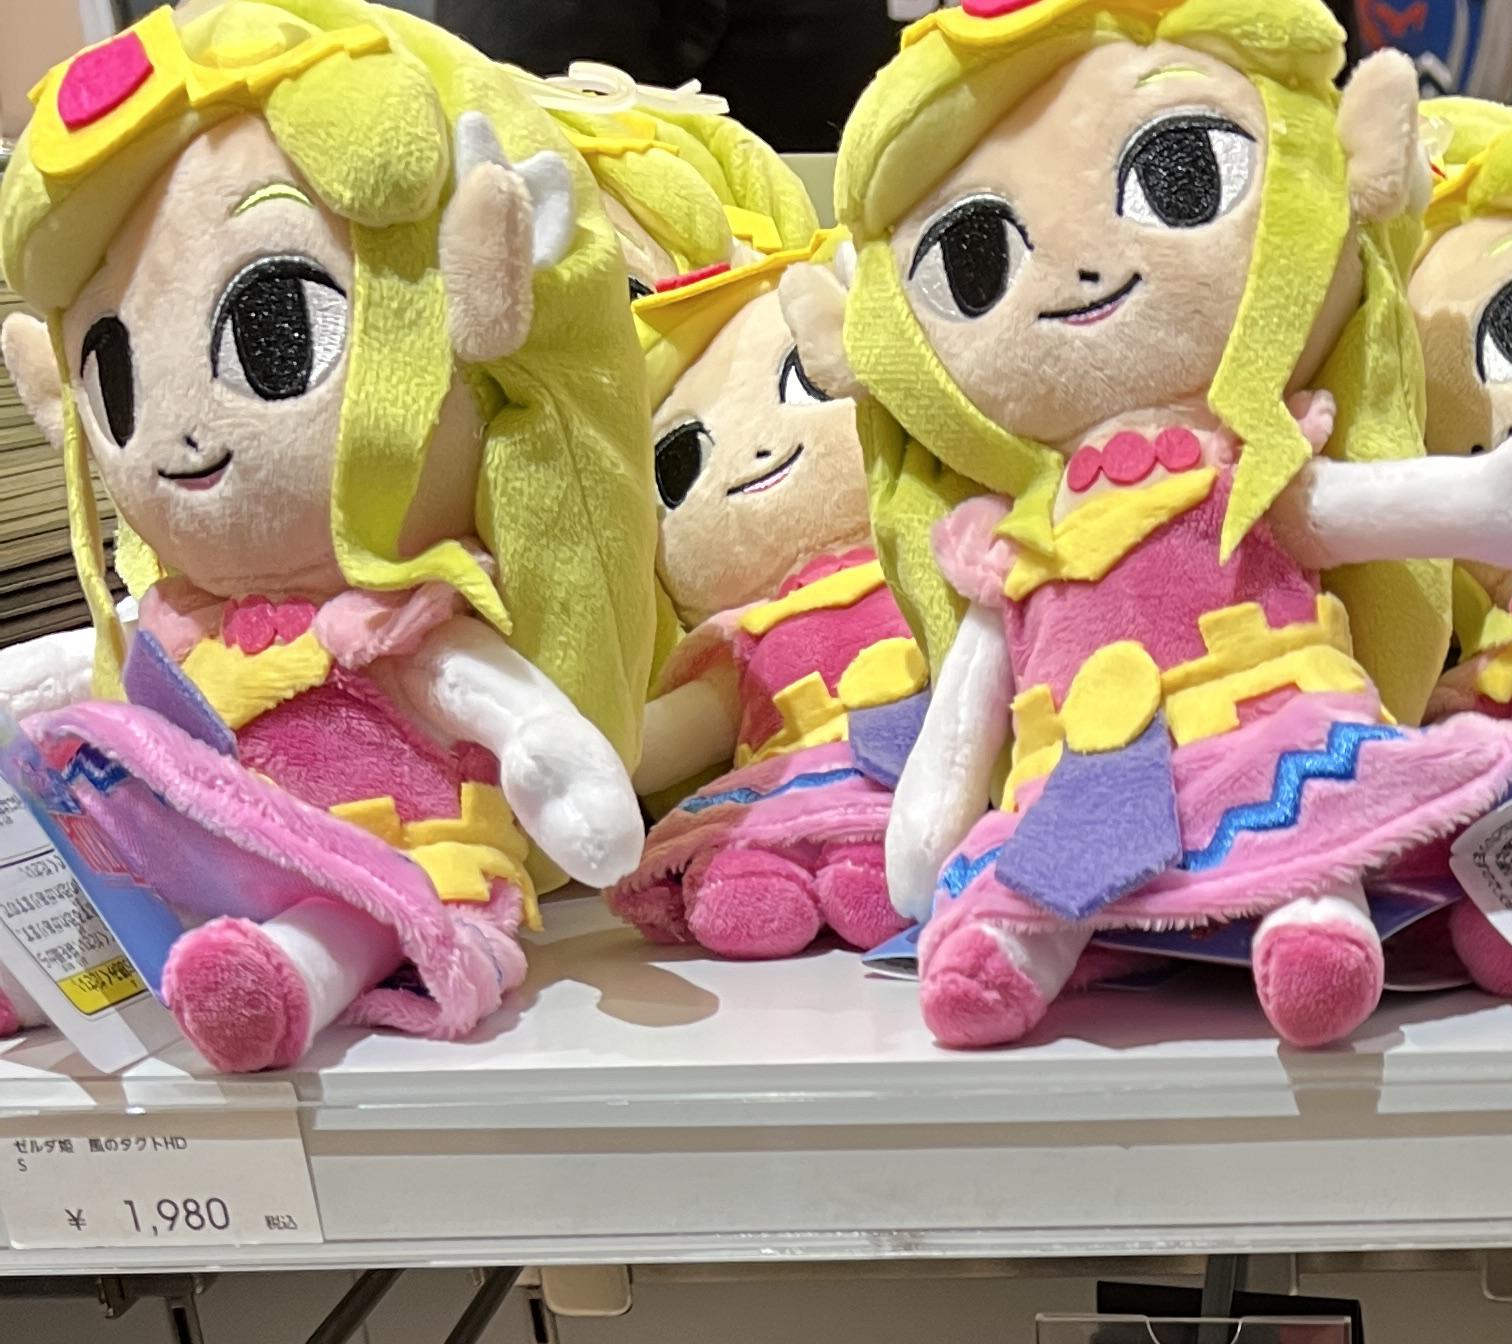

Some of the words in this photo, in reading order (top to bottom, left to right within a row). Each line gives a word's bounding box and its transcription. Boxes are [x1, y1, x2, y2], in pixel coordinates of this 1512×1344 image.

[13, 1138, 74, 1154] ゼルダ姫
[89, 1136, 188, 1152] 風のタクトHD
[17, 1159, 28, 1172] S
[123, 1198, 230, 1235] 1,980
